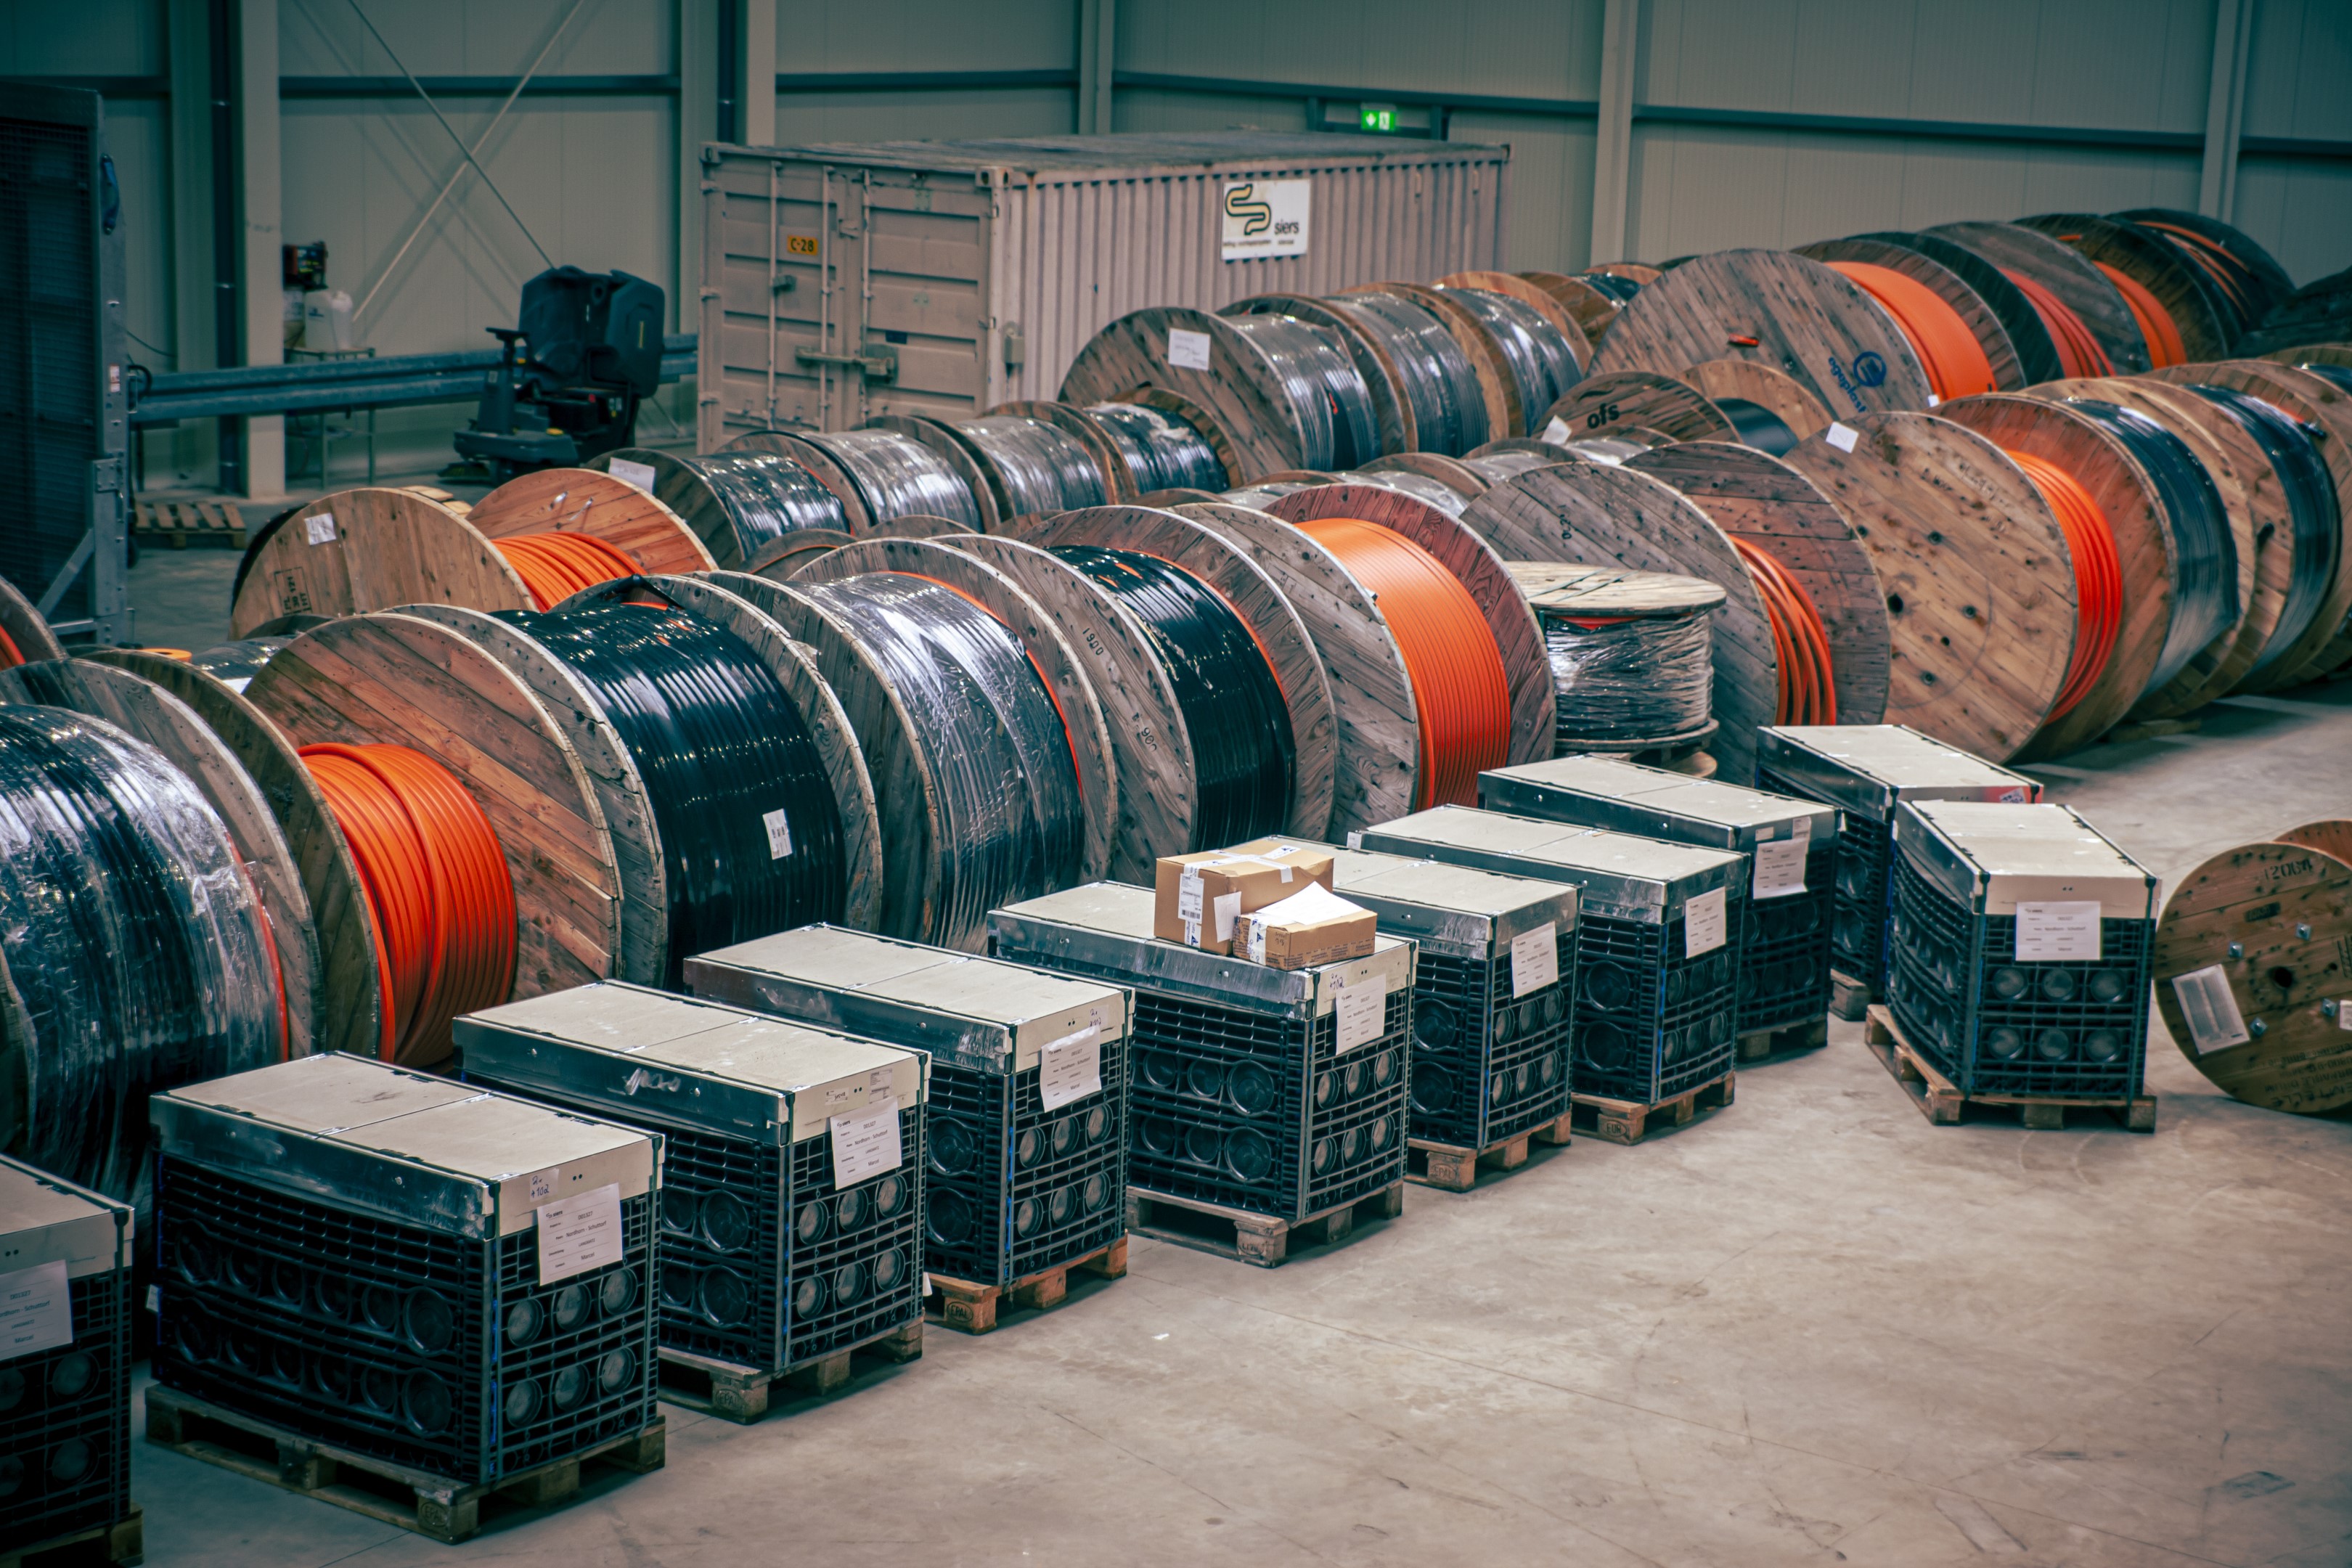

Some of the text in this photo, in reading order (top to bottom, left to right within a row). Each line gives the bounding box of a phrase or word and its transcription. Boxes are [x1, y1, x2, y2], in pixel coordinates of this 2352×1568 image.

[1274, 219, 1299, 234] siers
[791, 237, 814, 252] C-28
[1828, 356, 1867, 413] egeplast
[1587, 403, 1620, 429] ofs
[1082, 627, 1104, 656] 1900
[1606, 1122, 1621, 1135] EUR
[566, 1228, 585, 1238] Nordhorn
[950, 1304, 967, 1319] EPAL
[15, 1334, 34, 1344] Marcel
